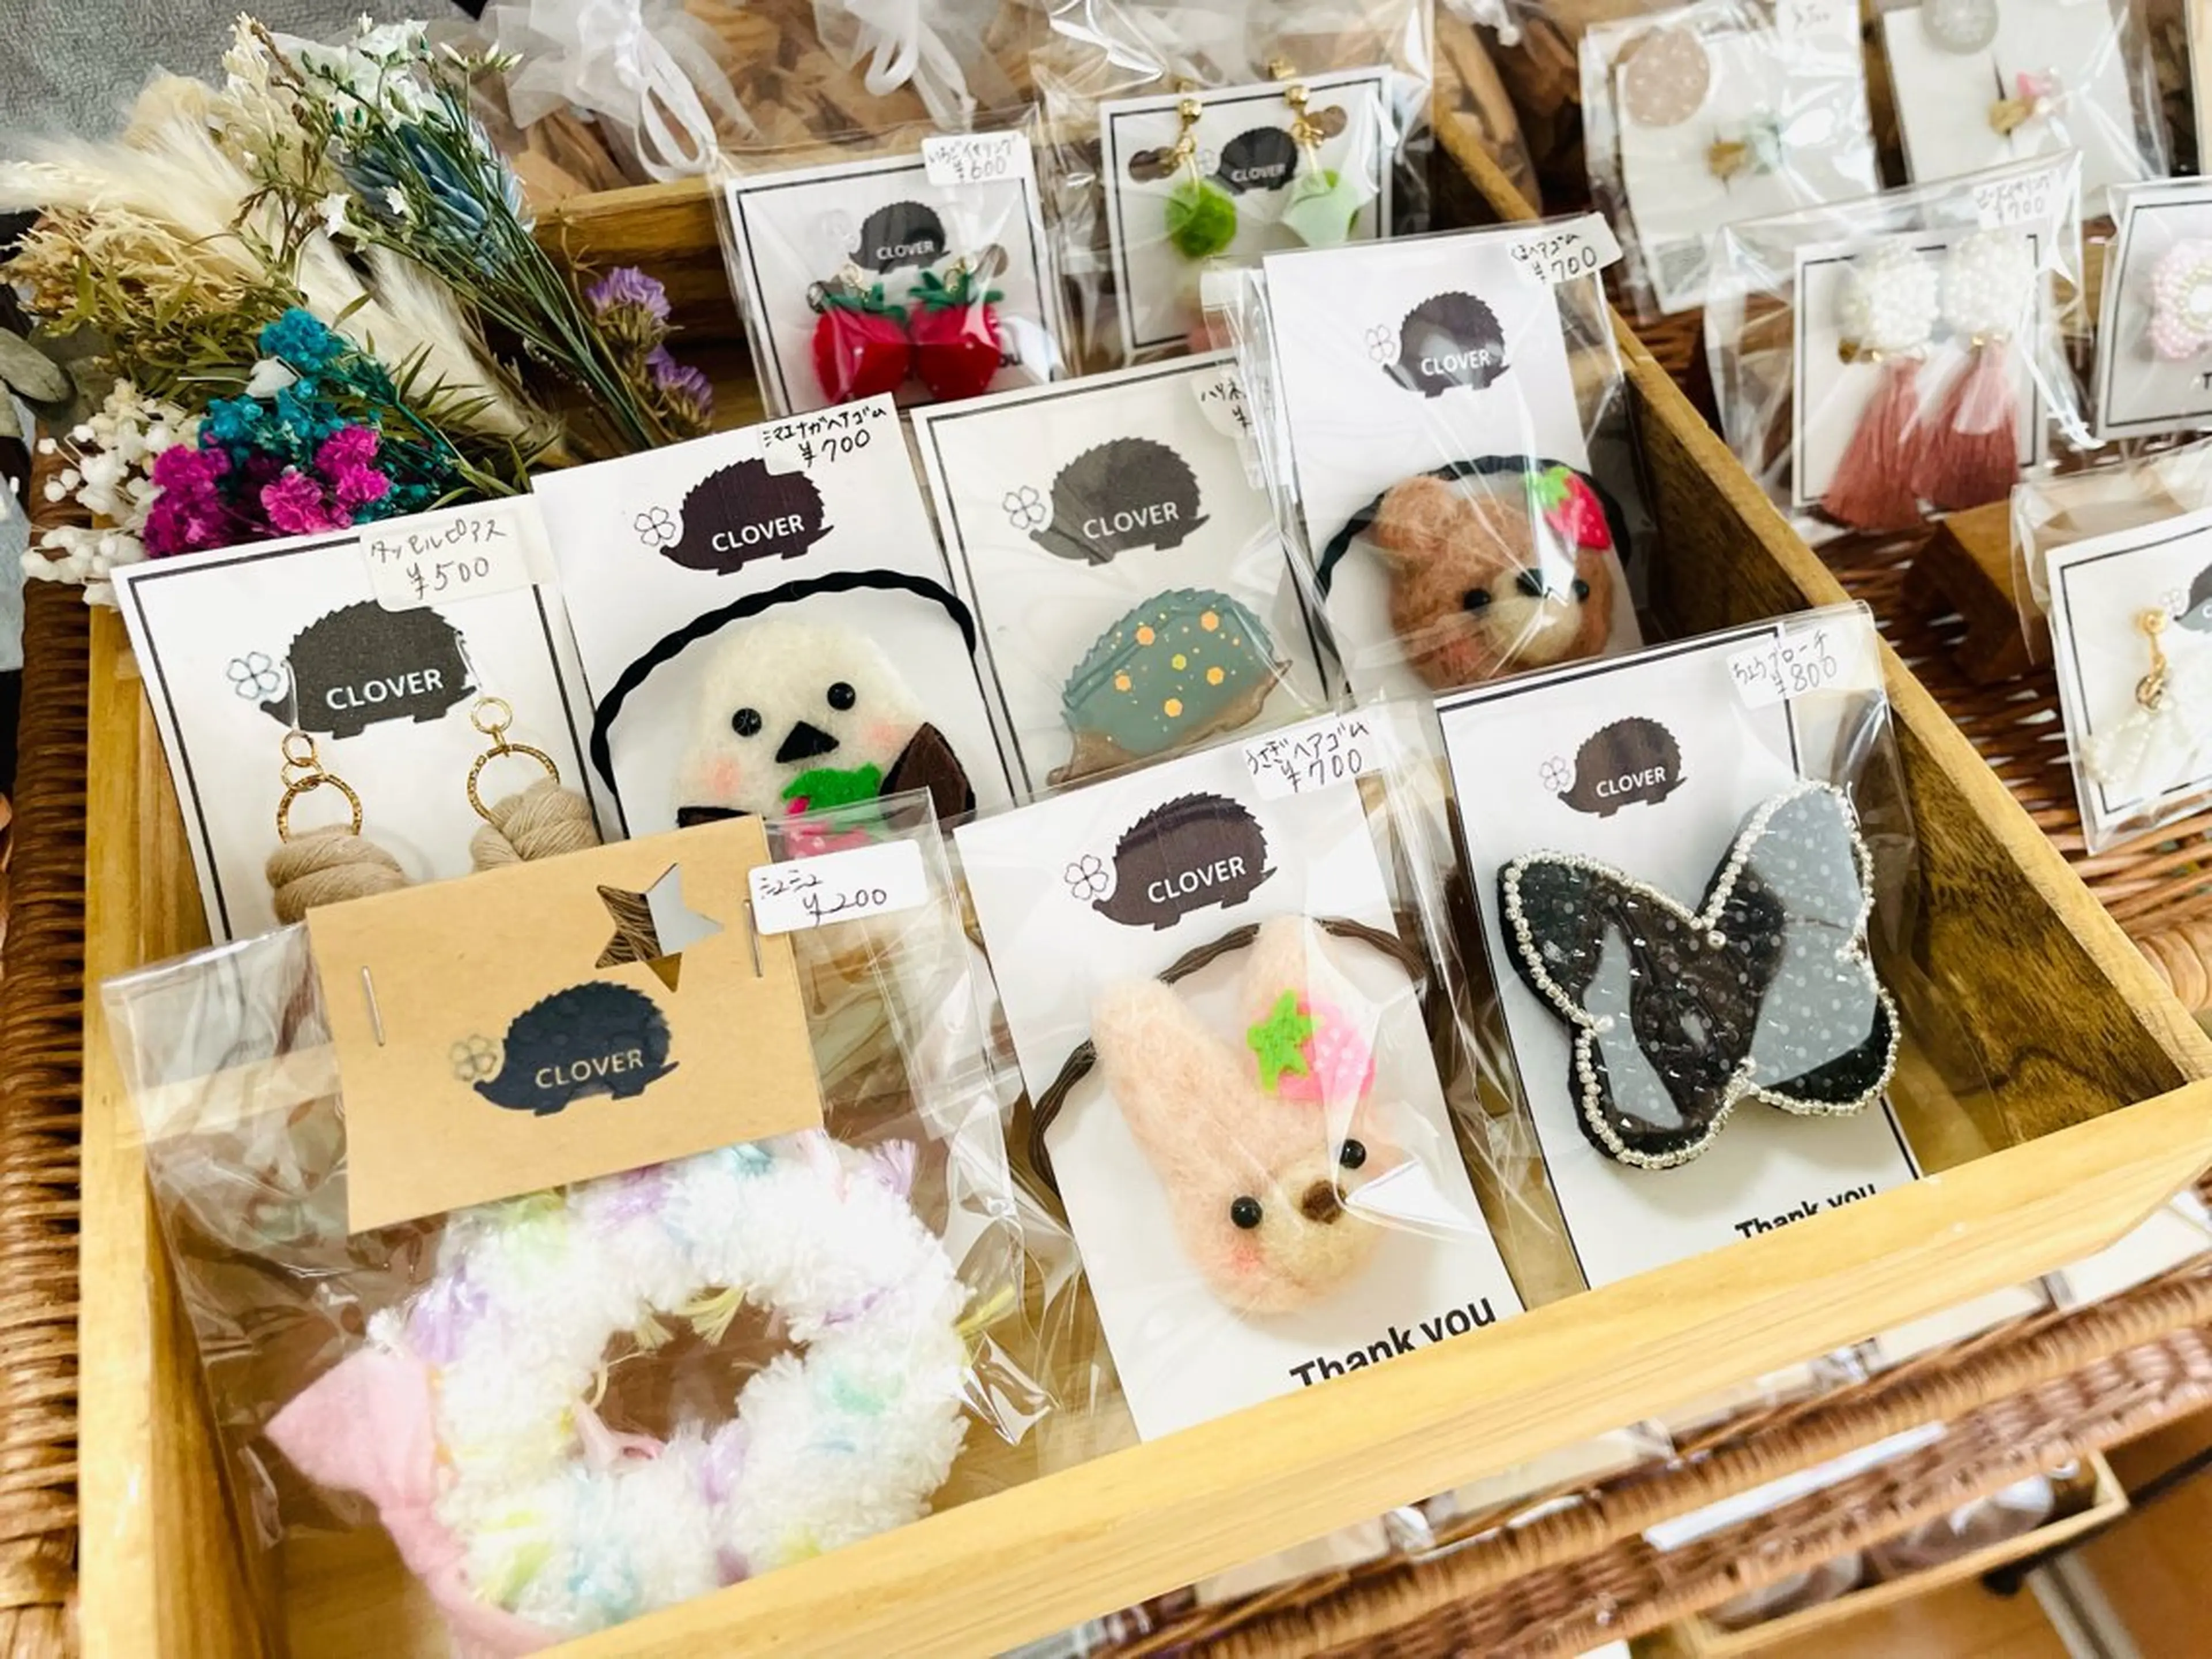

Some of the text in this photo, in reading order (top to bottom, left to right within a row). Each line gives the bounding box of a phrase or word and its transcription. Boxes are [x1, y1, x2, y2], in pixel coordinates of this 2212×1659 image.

[1231, 162, 1286, 183] CLOVER
[876, 240, 934, 260] CLOVER
[1532, 245, 1598, 286] ¥700
[1420, 349, 1491, 377] CLOVER
[798, 429, 872, 469] ¥700
[711, 513, 805, 552] CLOVER
[1083, 501, 1180, 539] CLOVER
[406, 556, 490, 601] ¥500
[326, 668, 444, 710] CLOVER
[1281, 749, 1362, 793] ¥700
[1595, 766, 1666, 798] CLOVER
[1147, 856, 1247, 903] CLOVER
[802, 888, 887, 927] ¥200
[534, 1048, 644, 1089] CLOVER
[1734, 1200, 1819, 1239] Thank
[1289, 1297, 1497, 1387] Thank you
